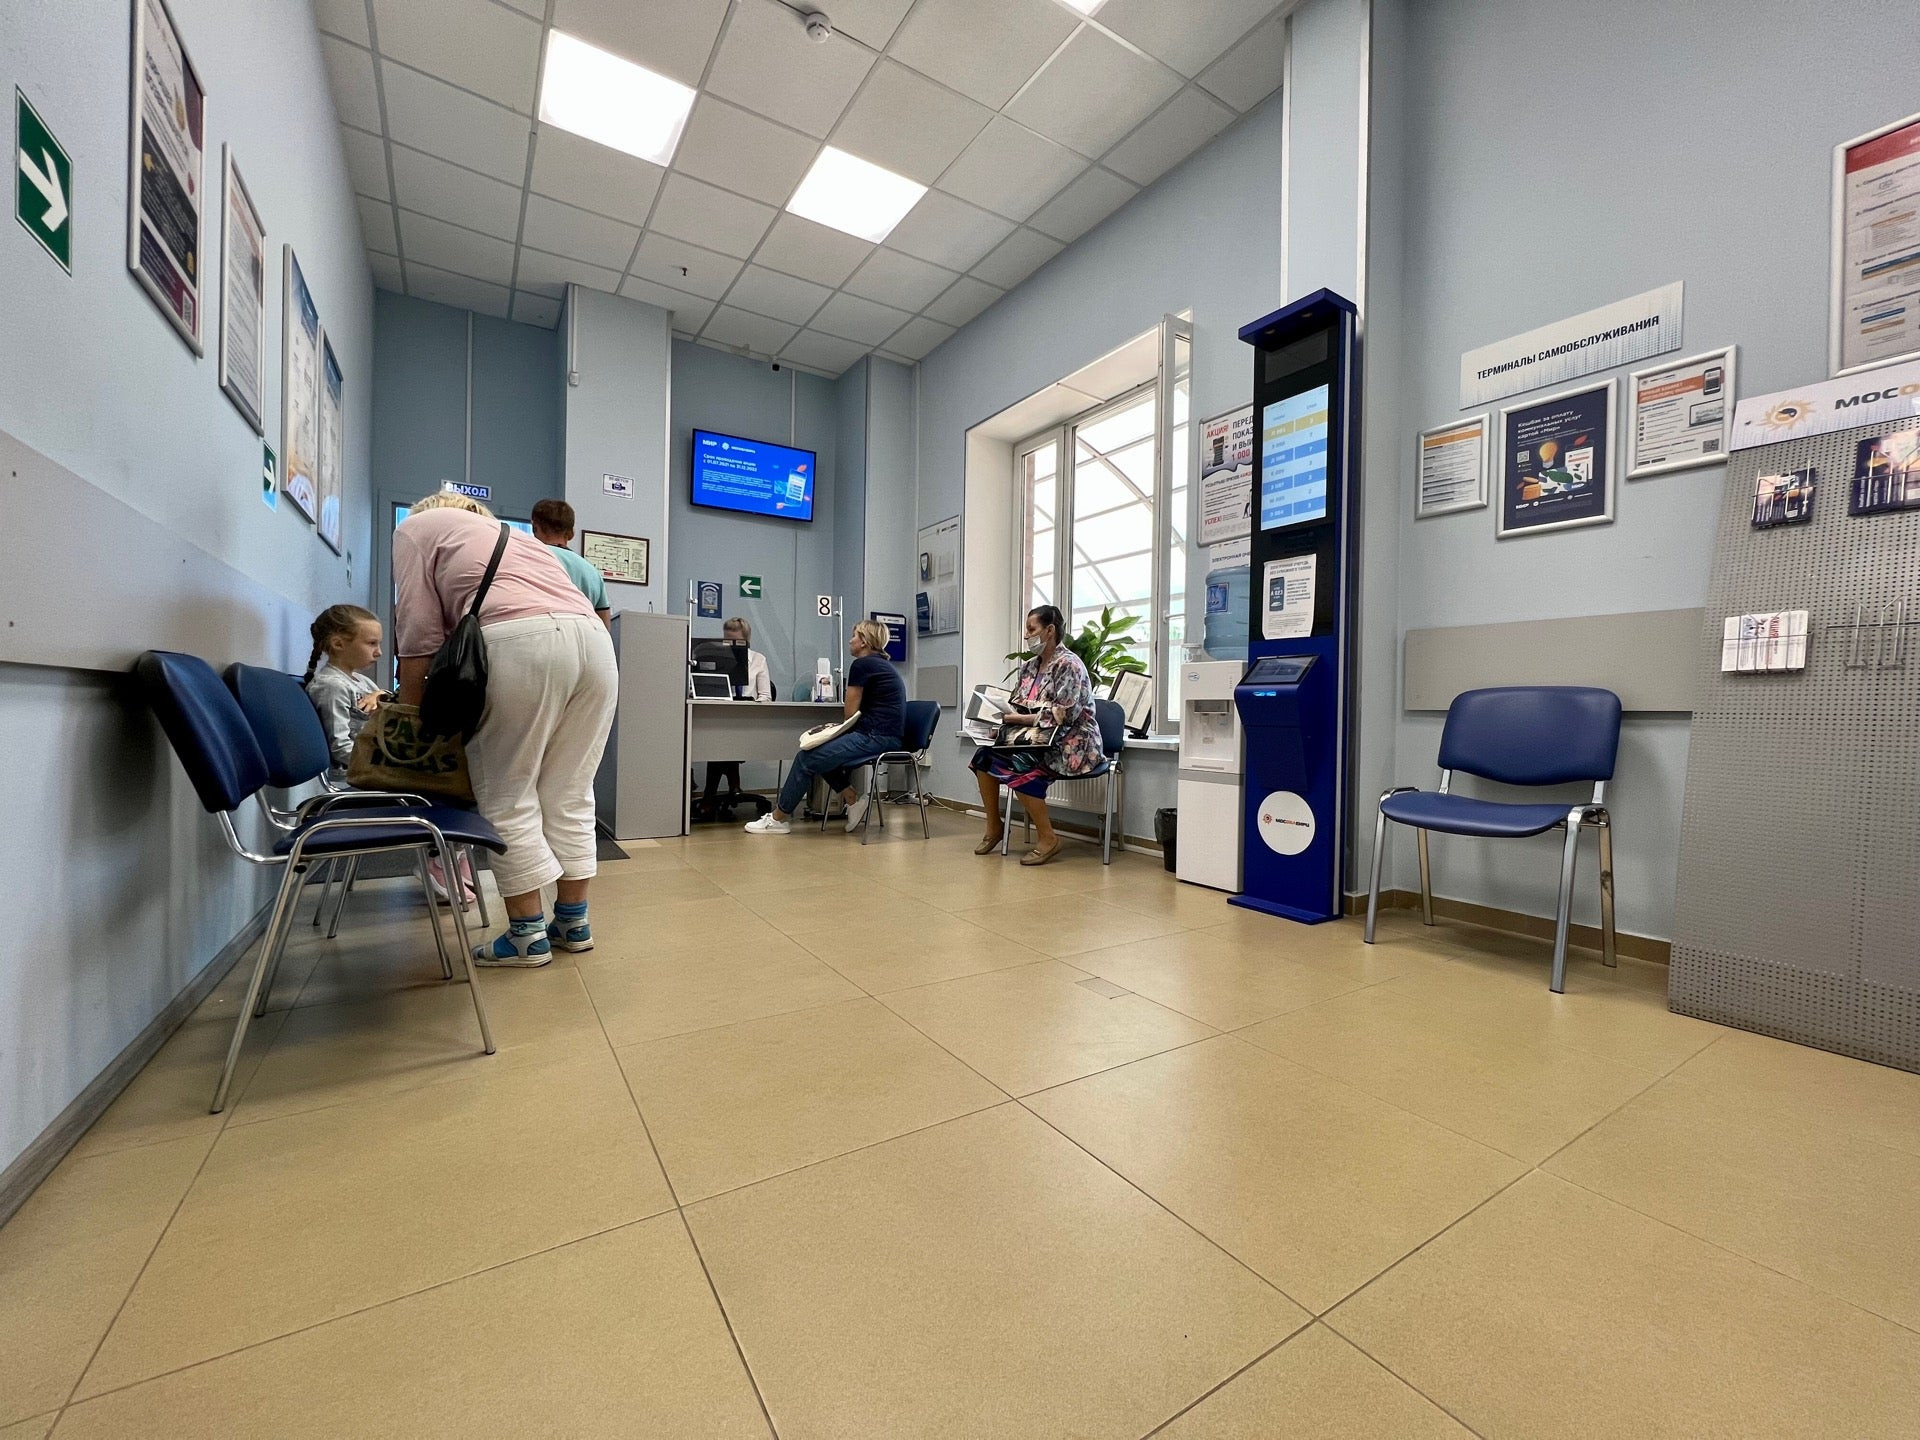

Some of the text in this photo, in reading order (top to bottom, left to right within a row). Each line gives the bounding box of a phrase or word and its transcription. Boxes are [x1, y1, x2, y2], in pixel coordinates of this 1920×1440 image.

[1477, 315, 1660, 380] ТЕРМИНАЛЫ САМООБСЛУЖИВАНИЯ
[1834, 383, 1920, 410] МОСО
[1237, 448, 1251, 460] 000
[445, 482, 488, 498] ВЫХОД
[819, 597, 830, 616] 8
